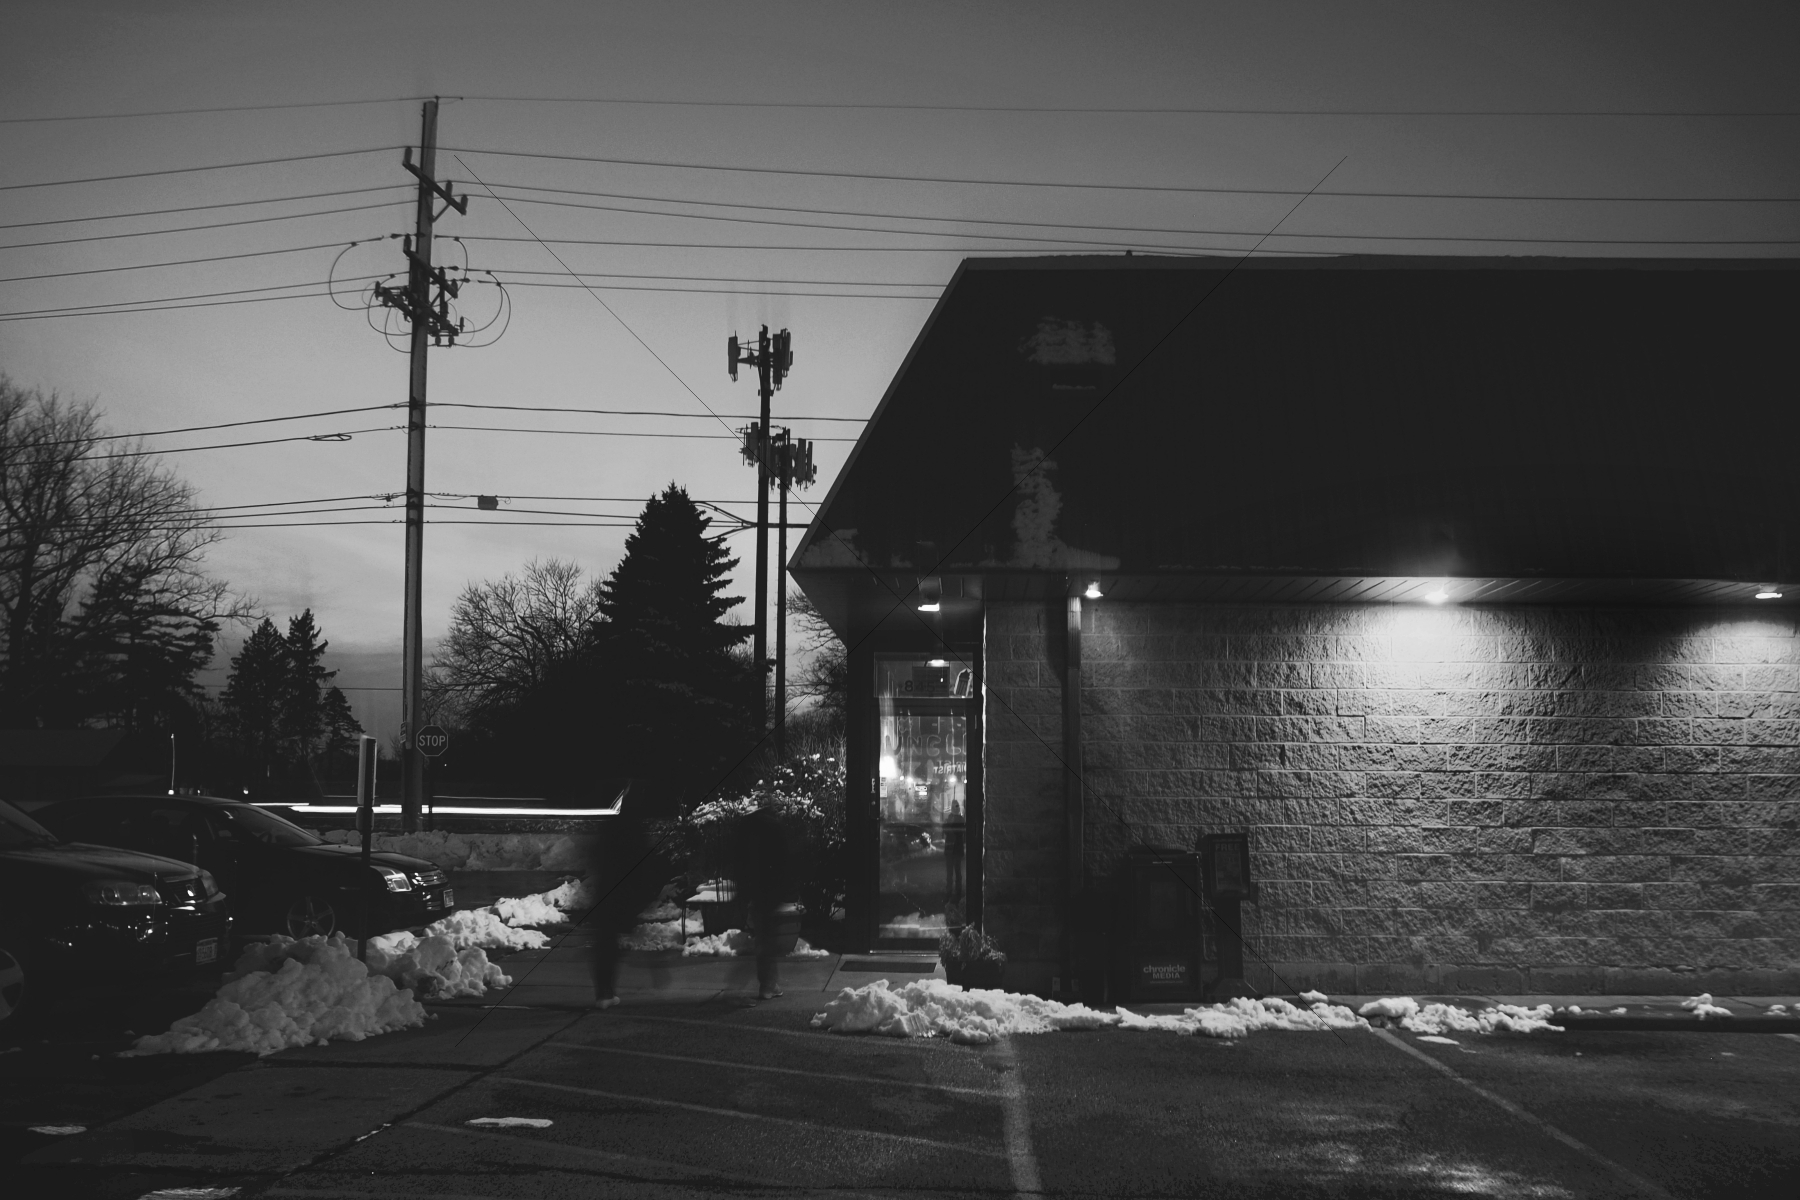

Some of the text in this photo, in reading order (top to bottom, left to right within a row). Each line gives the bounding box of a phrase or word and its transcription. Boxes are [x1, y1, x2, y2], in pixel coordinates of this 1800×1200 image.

[904, 680, 935, 692] 845
[419, 735, 446, 747] STOP
[1215, 843, 1240, 852] FREE
[1143, 964, 1186, 973] chronicle
